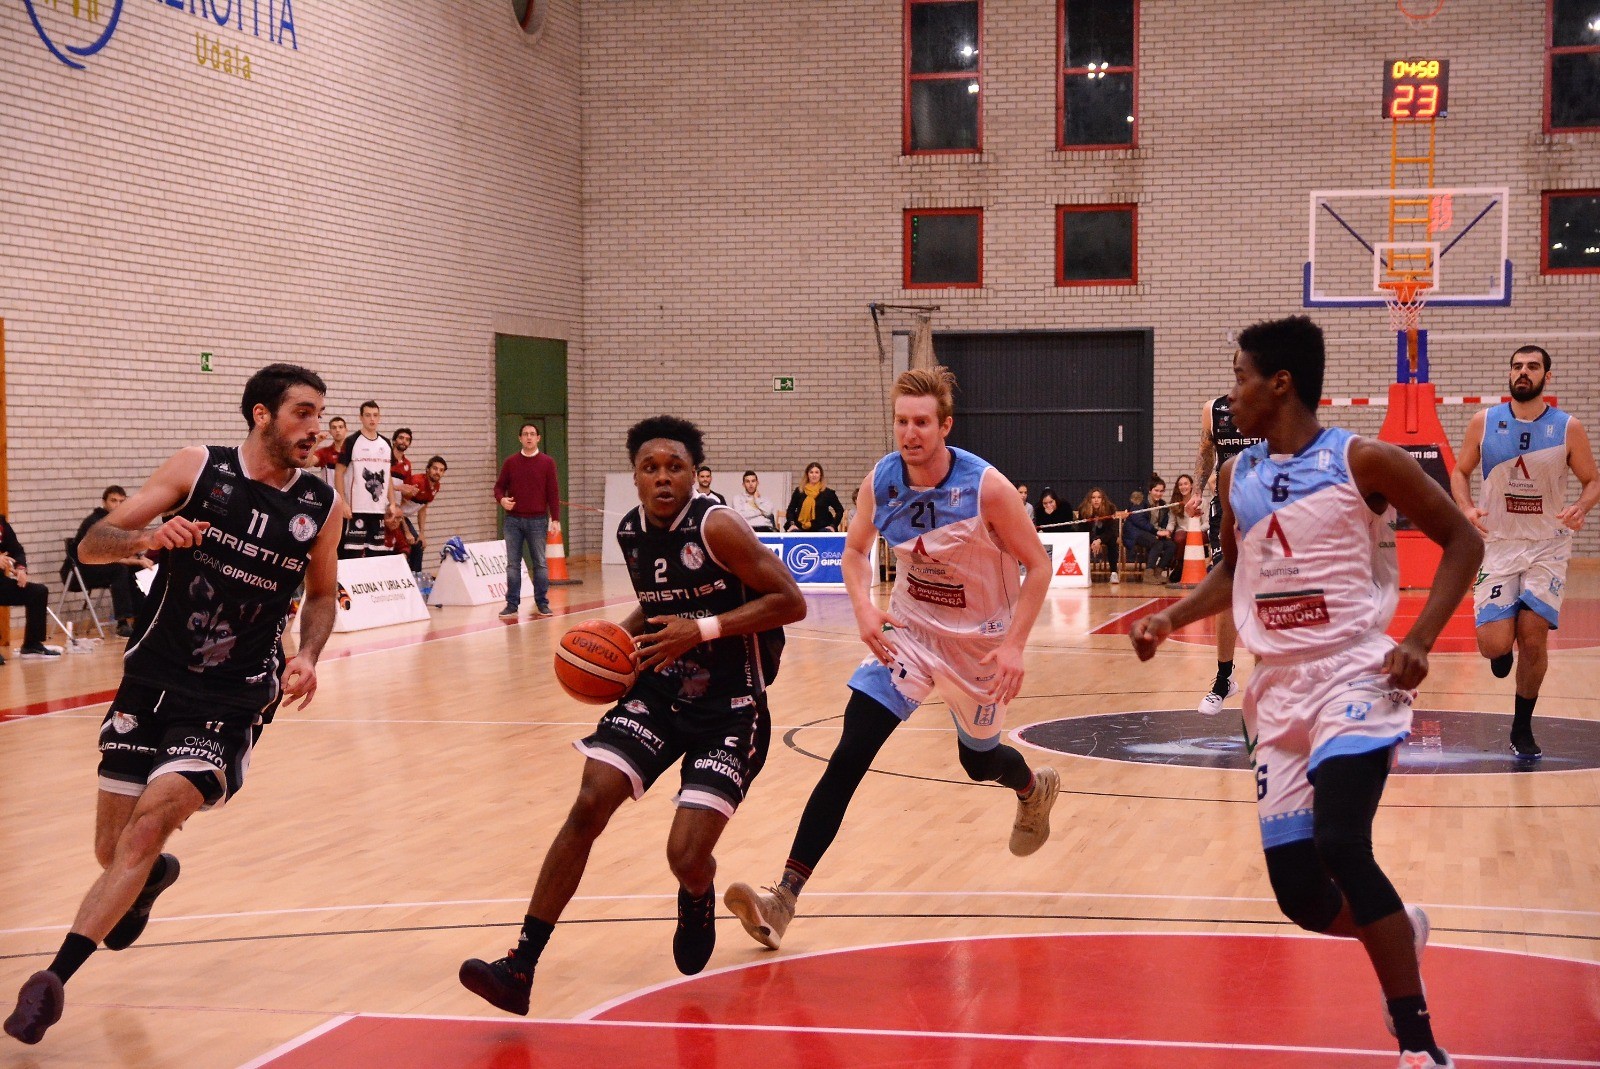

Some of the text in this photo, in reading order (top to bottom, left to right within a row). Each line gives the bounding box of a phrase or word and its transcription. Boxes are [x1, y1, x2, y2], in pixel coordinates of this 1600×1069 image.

[195, 31, 251, 79] Udala
[1390, 85, 1439, 118] 23
[1519, 432, 1531, 450] 9
[1271, 472, 1290, 503] 6
[246, 508, 269, 539] 11
[910, 501, 936, 529] 21
[654, 558, 668, 584] 2
[820, 558, 842, 566] GIPU
[1259, 566, 1300, 578] Aquimisa
[351, 582, 379, 595] ALTUNA
[377, 581, 384, 591] Y
[384, 579, 402, 591] URIA
[487, 582, 507, 599] RIO
[1269, 607, 1325, 625] ZAMORA
